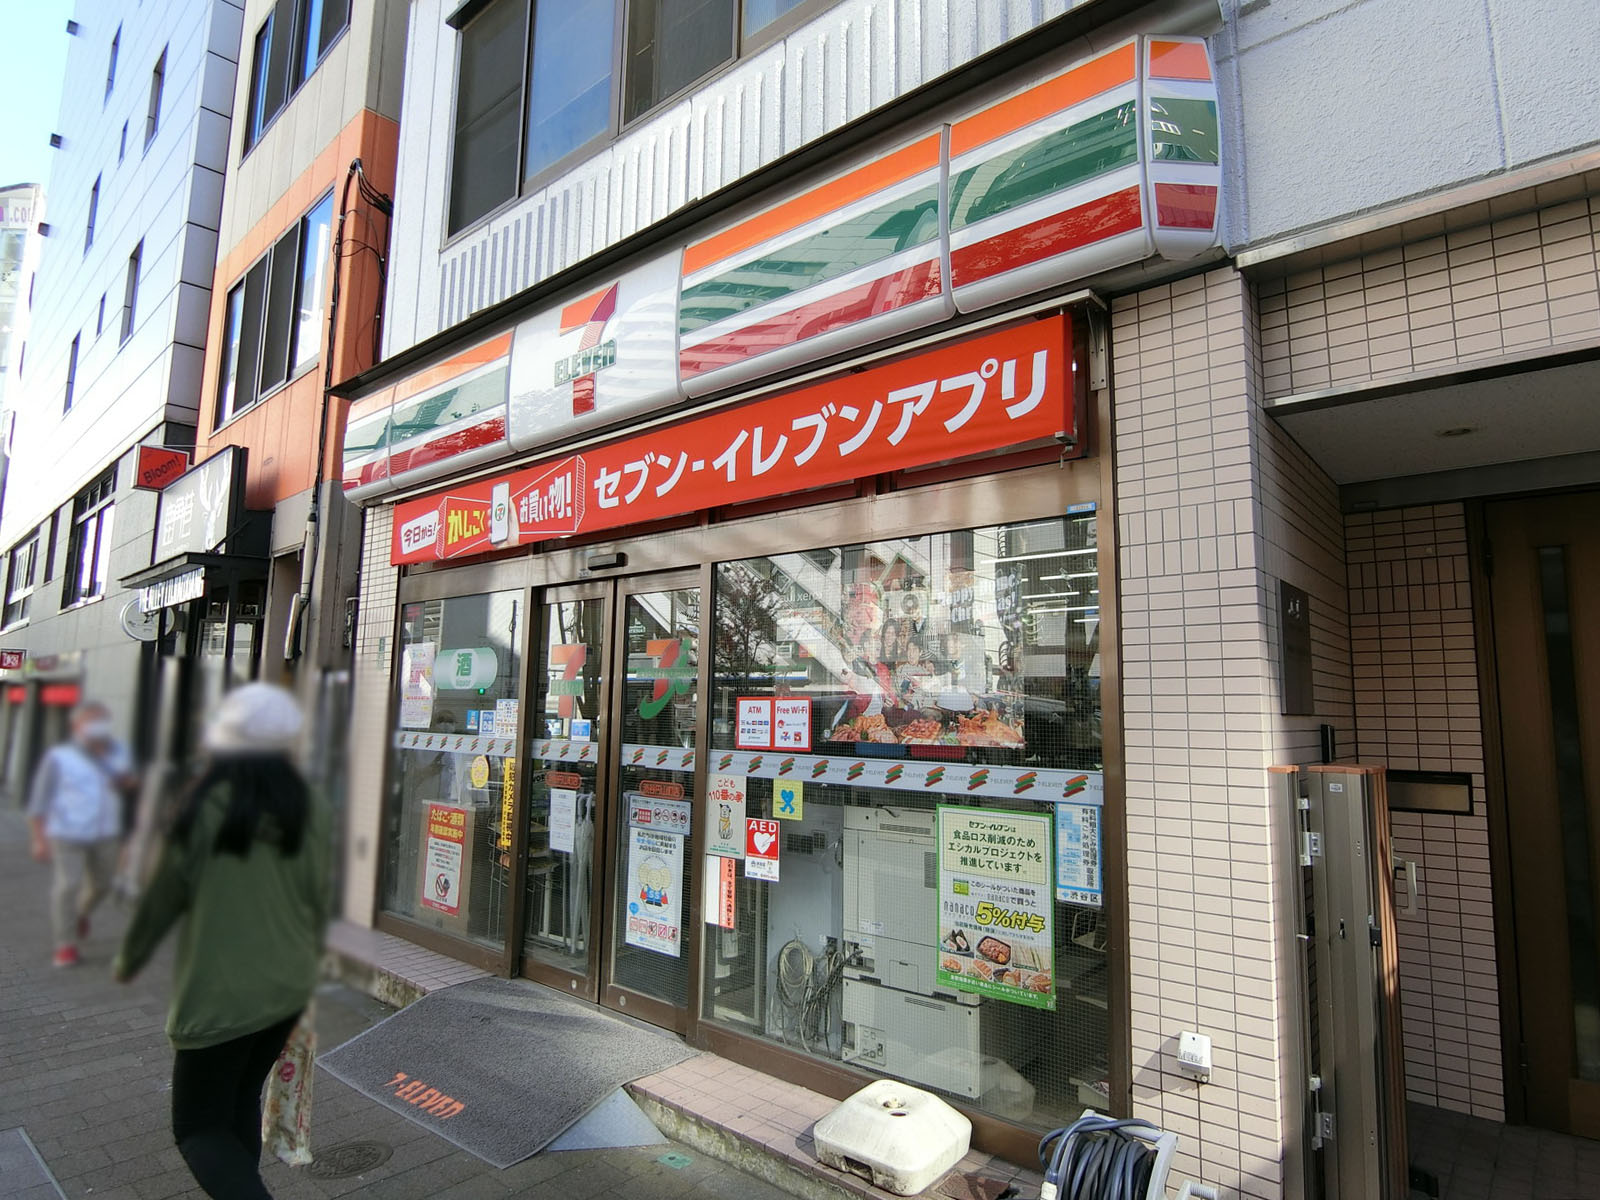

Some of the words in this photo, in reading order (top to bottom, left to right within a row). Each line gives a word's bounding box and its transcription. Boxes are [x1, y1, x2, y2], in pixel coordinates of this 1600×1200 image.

[143, 455, 182, 484] Bloom!
[448, 509, 486, 545] かしこく
[456, 652, 473, 677] 酒
[748, 706, 762, 714] ATM
[777, 706, 790, 714] Free
[791, 706, 808, 714] Wi-Fi
[718, 779, 735, 788] こども
[709, 789, 744, 803] 110番の家
[749, 821, 777, 833] AED
[953, 829, 1036, 849] 食品ロス削減のため
[948, 842, 1043, 863] エシカルプロジェクトを
[960, 856, 1028, 874] 推進しています。
[971, 880, 1036, 897] このシールがついた商品を
